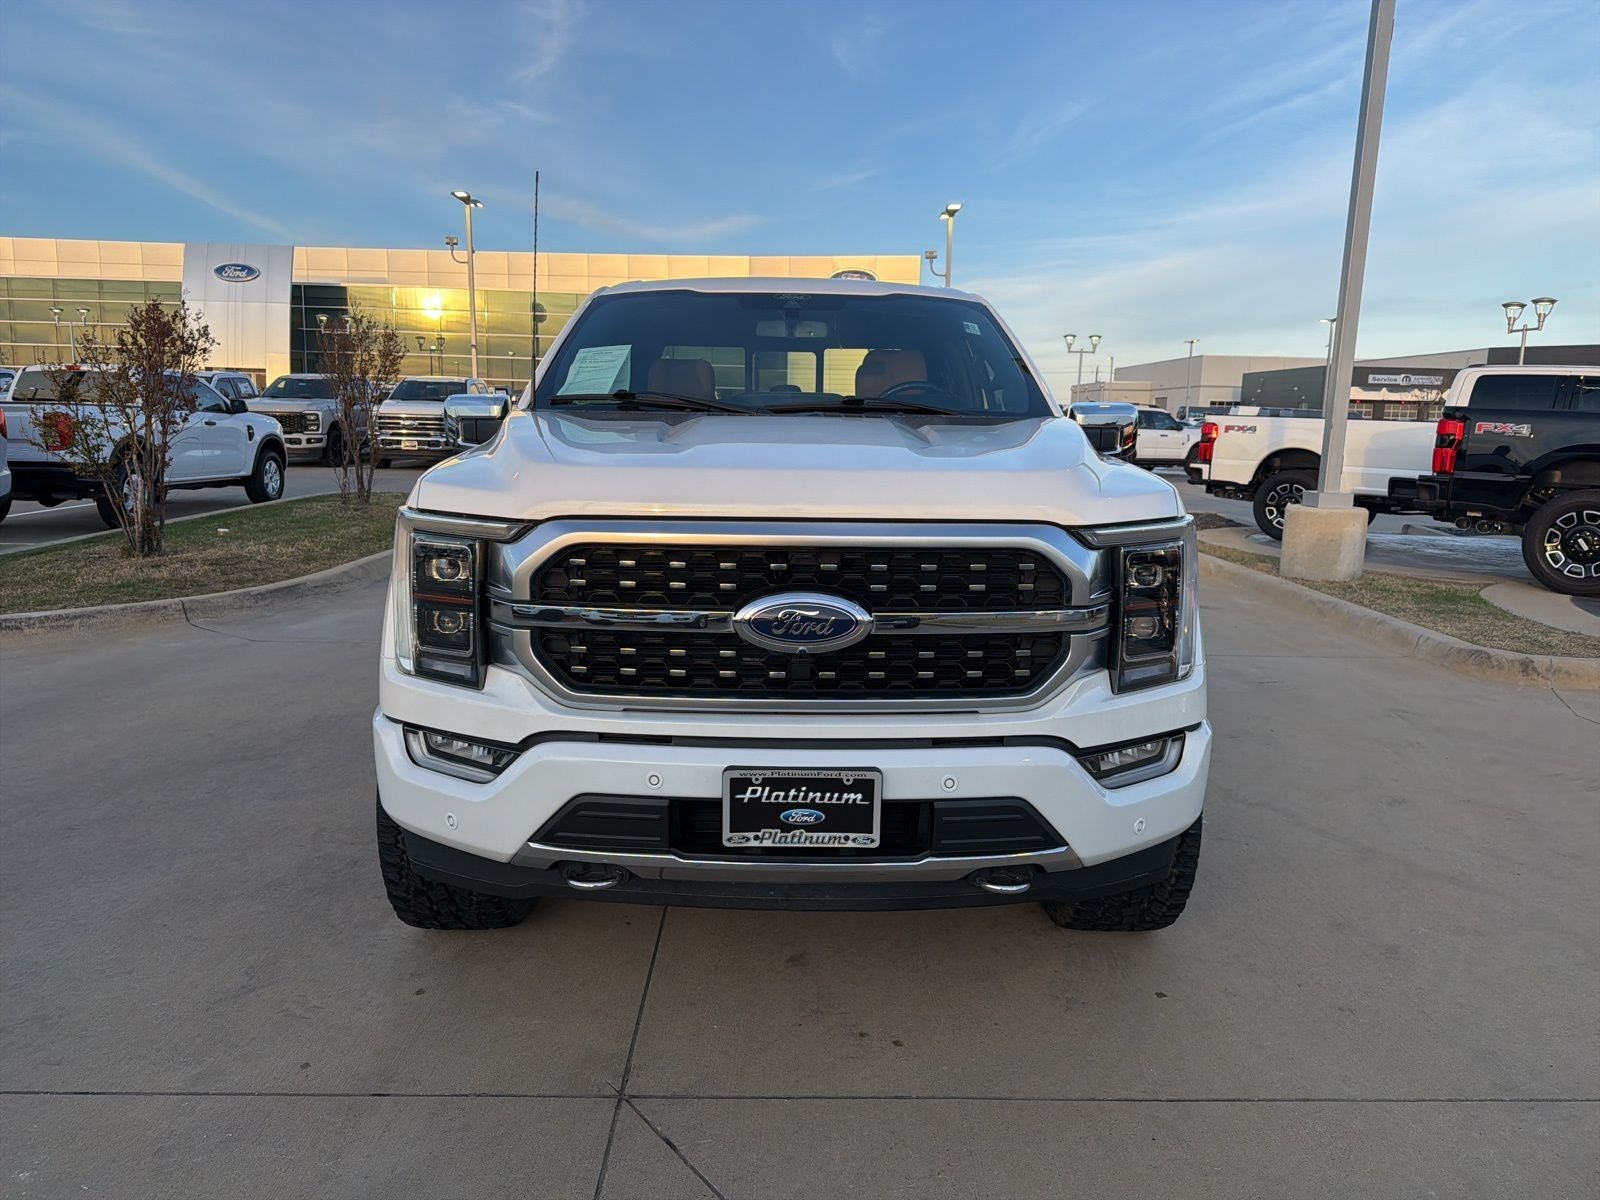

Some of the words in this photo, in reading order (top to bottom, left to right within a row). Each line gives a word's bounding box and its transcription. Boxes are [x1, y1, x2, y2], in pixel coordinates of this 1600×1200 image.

[222, 265, 248, 277] Ford
[1224, 425, 1257, 434] FX4
[1475, 422, 1531, 436] FX4
[771, 608, 836, 636] Ford
[734, 786, 871, 805] Platinum
[788, 810, 816, 823] Ford
[759, 829, 848, 845] Platinum
